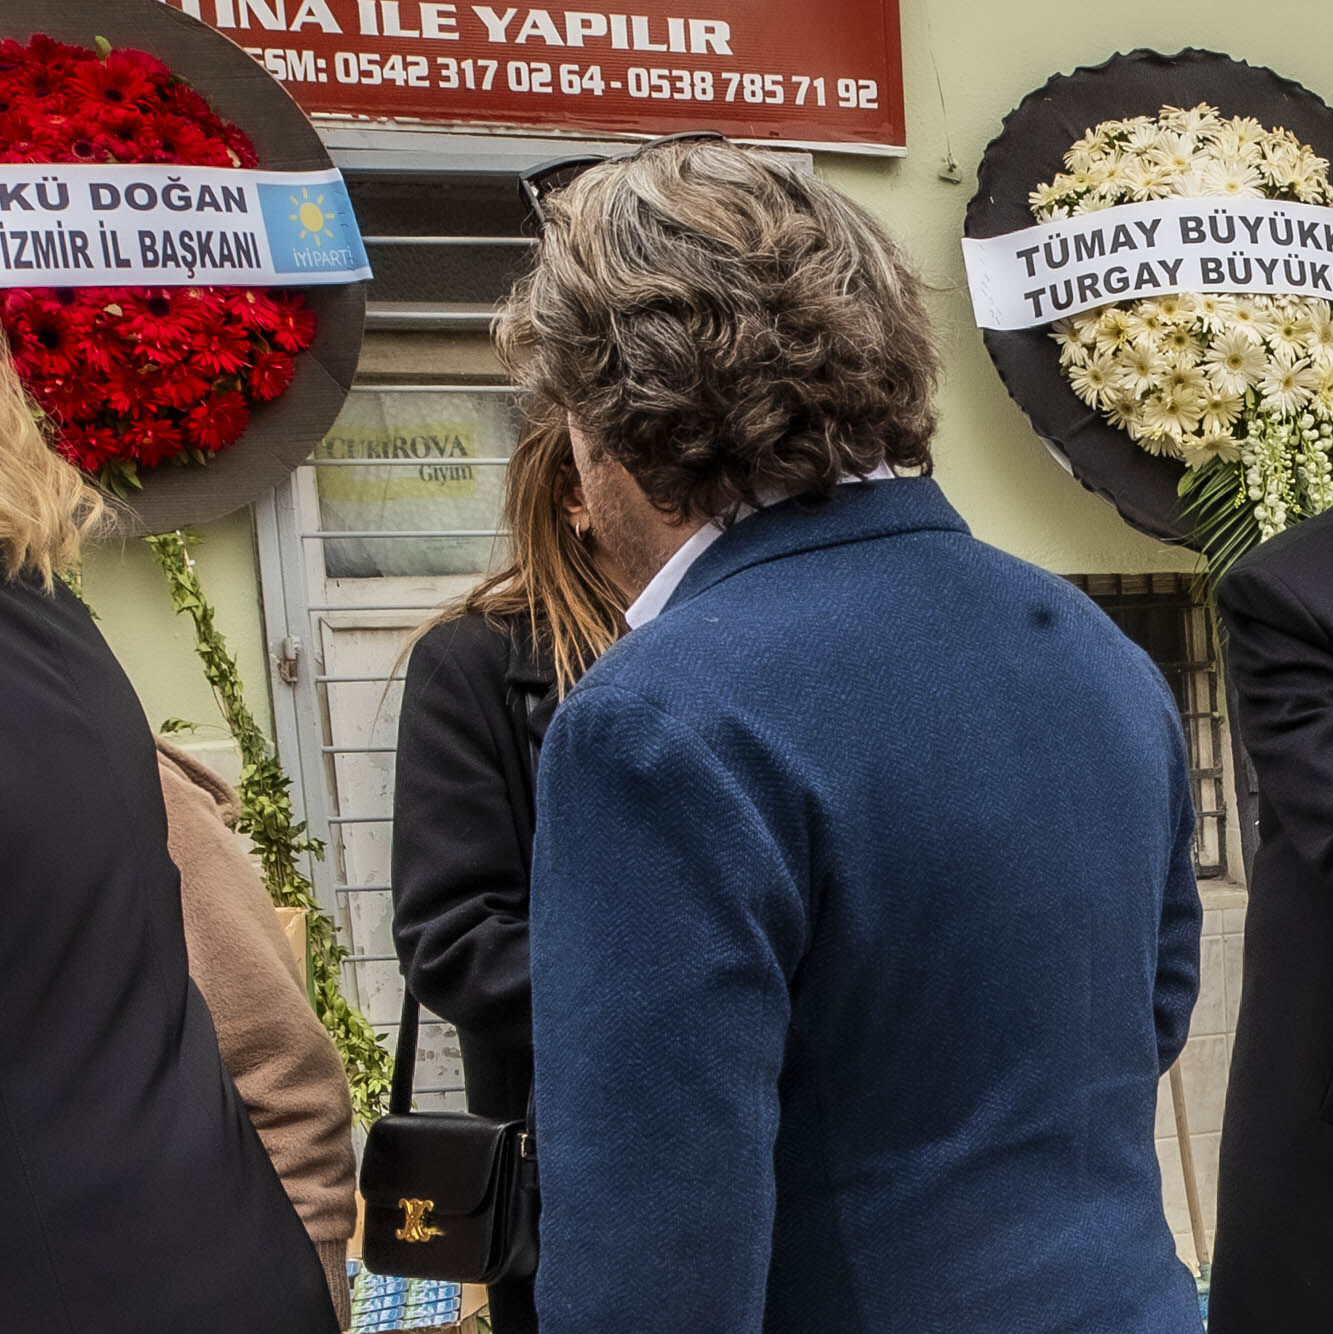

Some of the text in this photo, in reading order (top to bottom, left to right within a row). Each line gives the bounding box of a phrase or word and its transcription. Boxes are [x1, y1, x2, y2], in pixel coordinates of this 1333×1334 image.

[182, 0, 343, 34] INA
[471, 6, 734, 55] YAPILIR
[335, 51, 430, 87] 0542
[438, 58, 498, 90] 317
[507, 61, 553, 93] 02
[559, 64, 605, 96] 64
[627, 67, 715, 102] 0538
[721, 72, 785, 105] 785
[791, 75, 826, 106] 71
[837, 78, 879, 109] 92
[0, 176, 249, 214] KÜ DOĞAN
[0, 219, 262, 280] İZMİR İL BAŞKANI
[1016, 217, 1163, 278] TÜMAY
[1024, 257, 1184, 318] TURGAY
